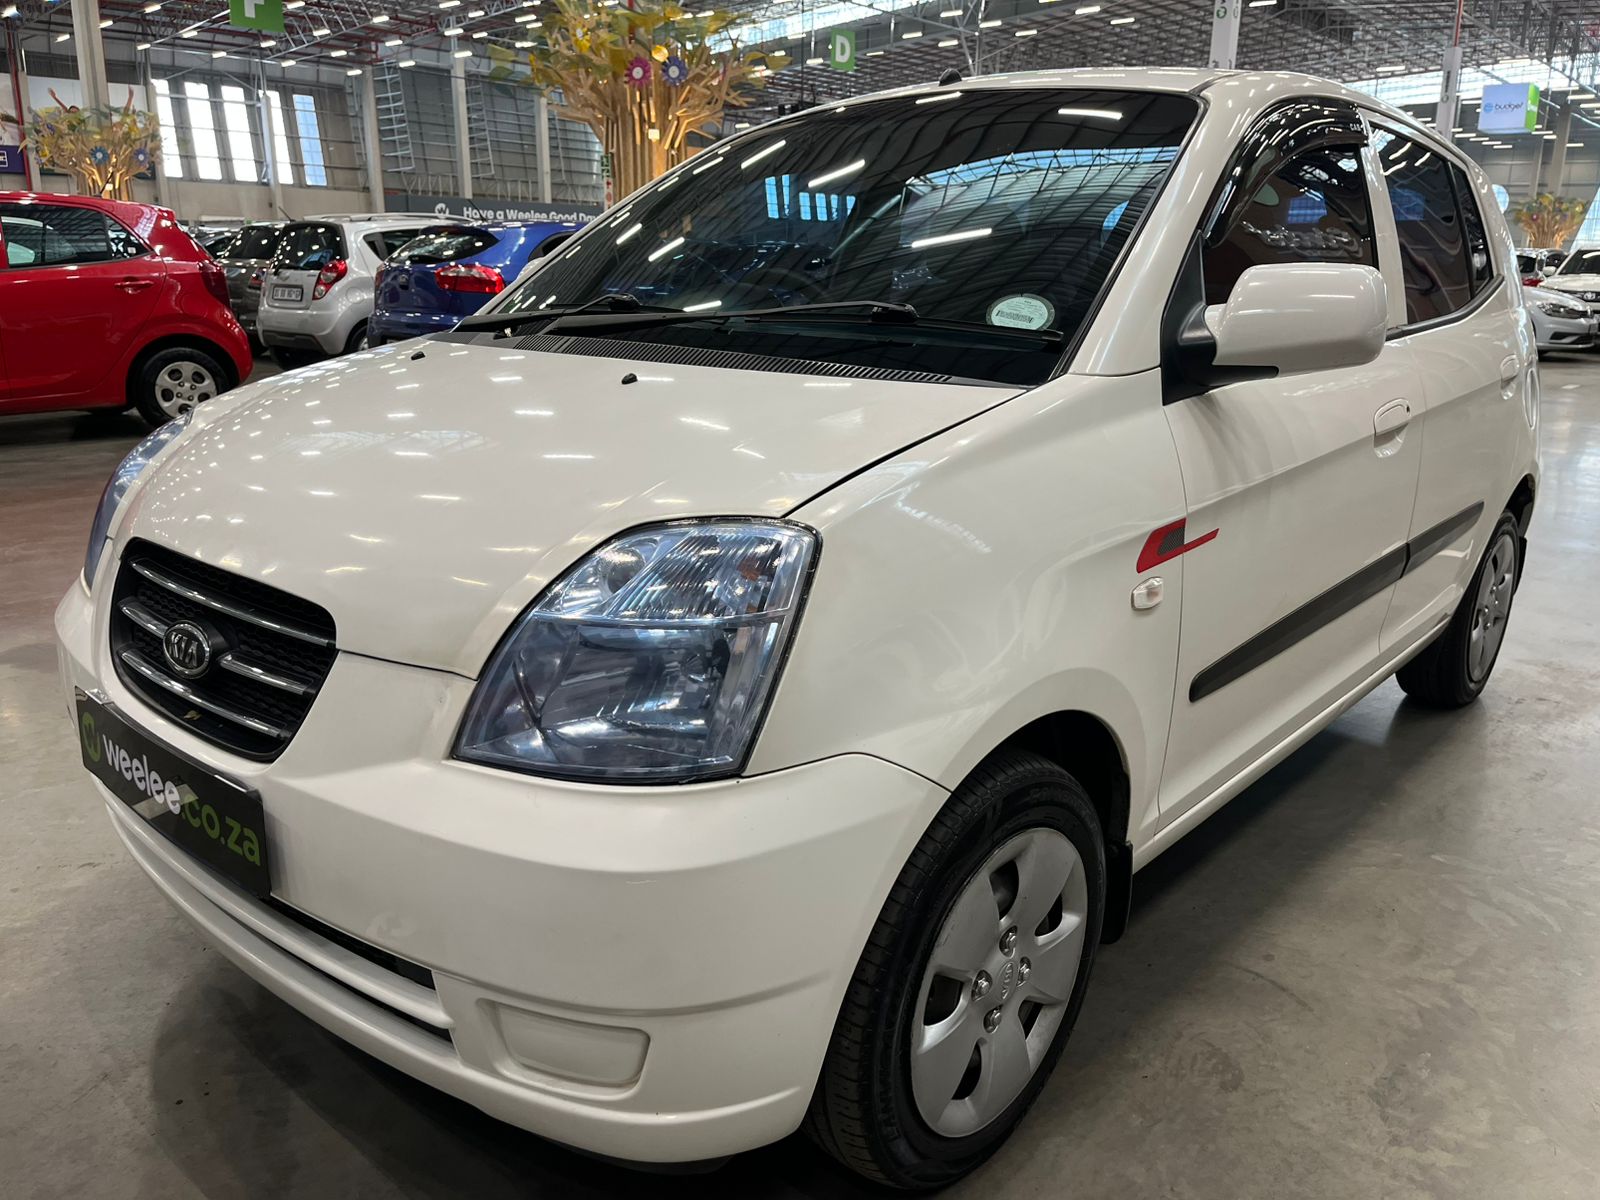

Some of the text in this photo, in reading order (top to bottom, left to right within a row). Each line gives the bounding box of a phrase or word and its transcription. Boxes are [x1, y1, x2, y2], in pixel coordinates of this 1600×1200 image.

[835, 34, 850, 63] D
[463, 207, 494, 219] Have
[496, 210, 504, 220] a
[169, 631, 198, 667] KIA
[103, 734, 261, 866] weelee.co.za
